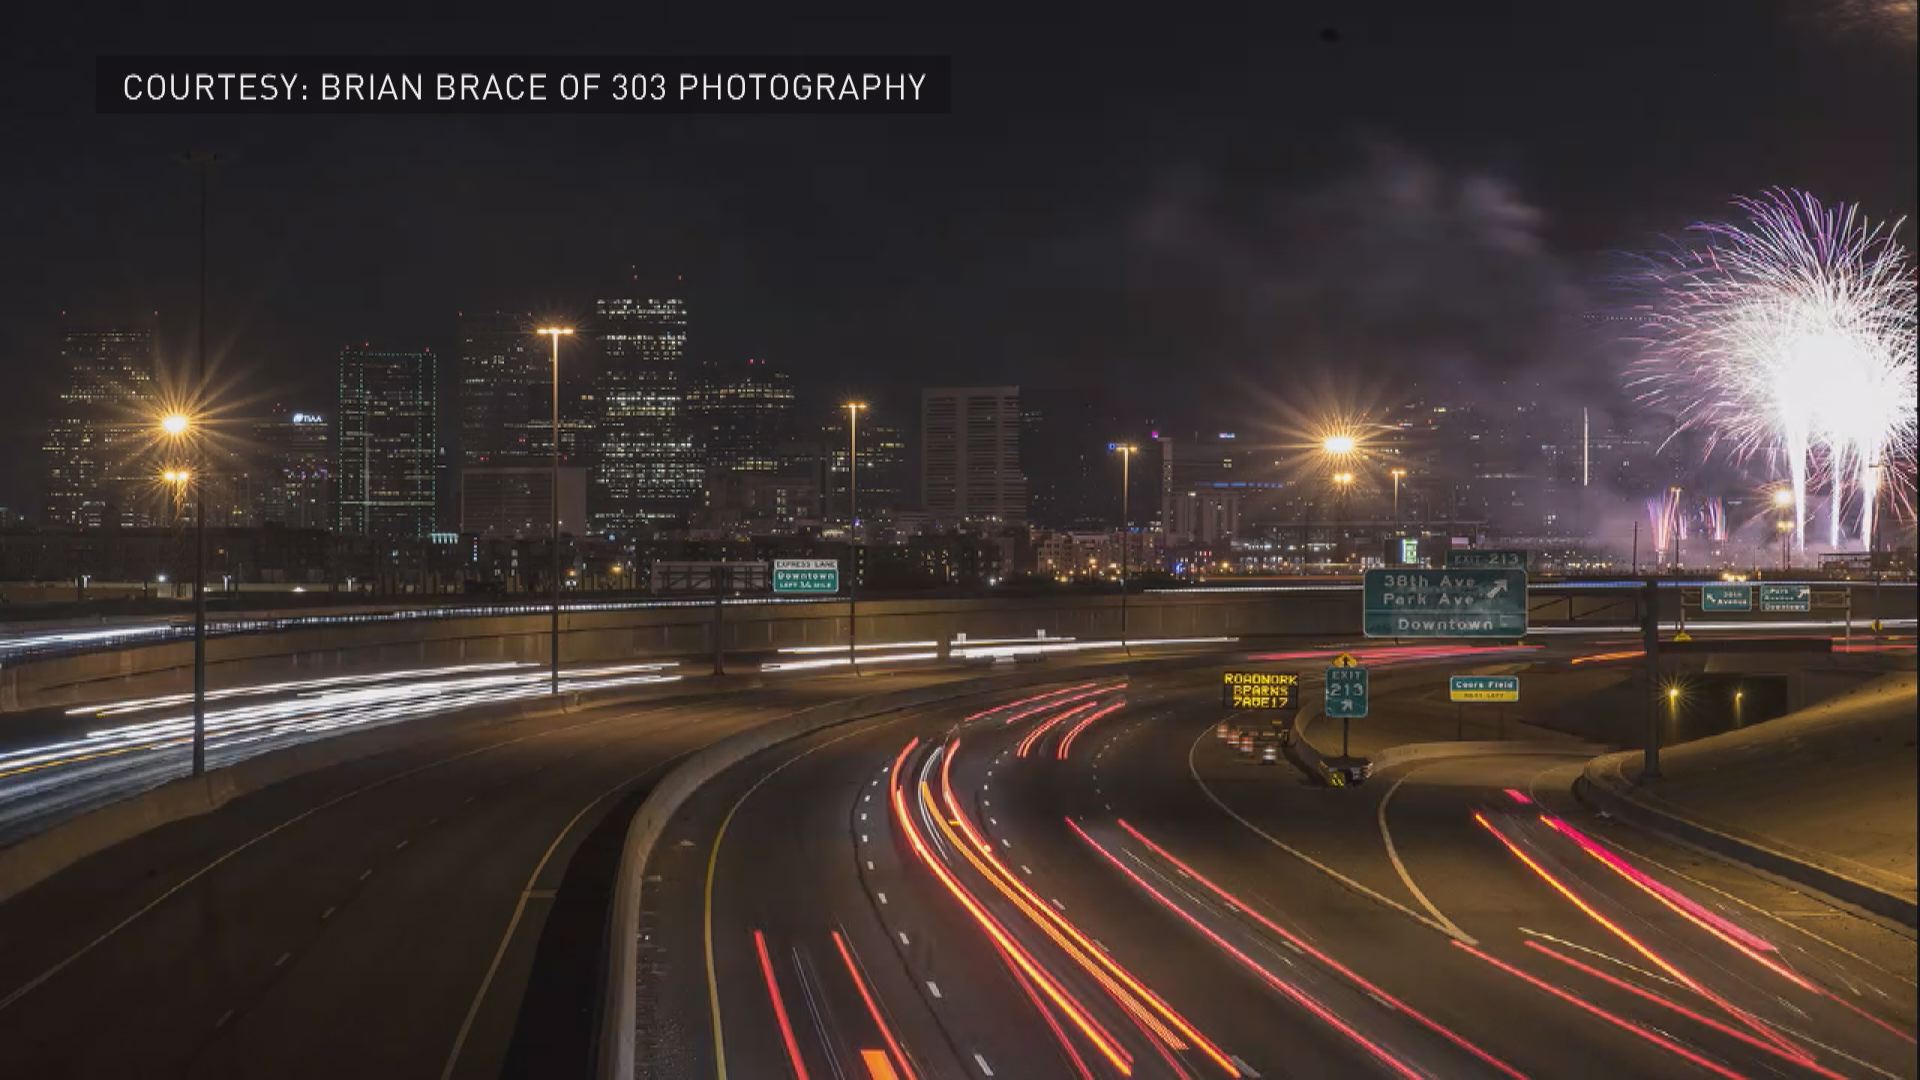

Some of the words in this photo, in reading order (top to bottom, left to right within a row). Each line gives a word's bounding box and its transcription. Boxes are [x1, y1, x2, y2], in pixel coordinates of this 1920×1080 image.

[1454, 555, 1482, 564] EXIT
[1488, 553, 1519, 564] 213
[778, 572, 834, 580] Downtown
[1384, 574, 1429, 588] 38th
[1439, 574, 1475, 588] Ave
[1383, 592, 1426, 606] Park
[1439, 592, 1475, 606] Ave
[1398, 617, 1493, 631] Downtown
[1331, 671, 1361, 679] EXIT
[1330, 682, 1363, 697] 213
[1456, 680, 1484, 688] Coors
[1488, 680, 1513, 688] Field
